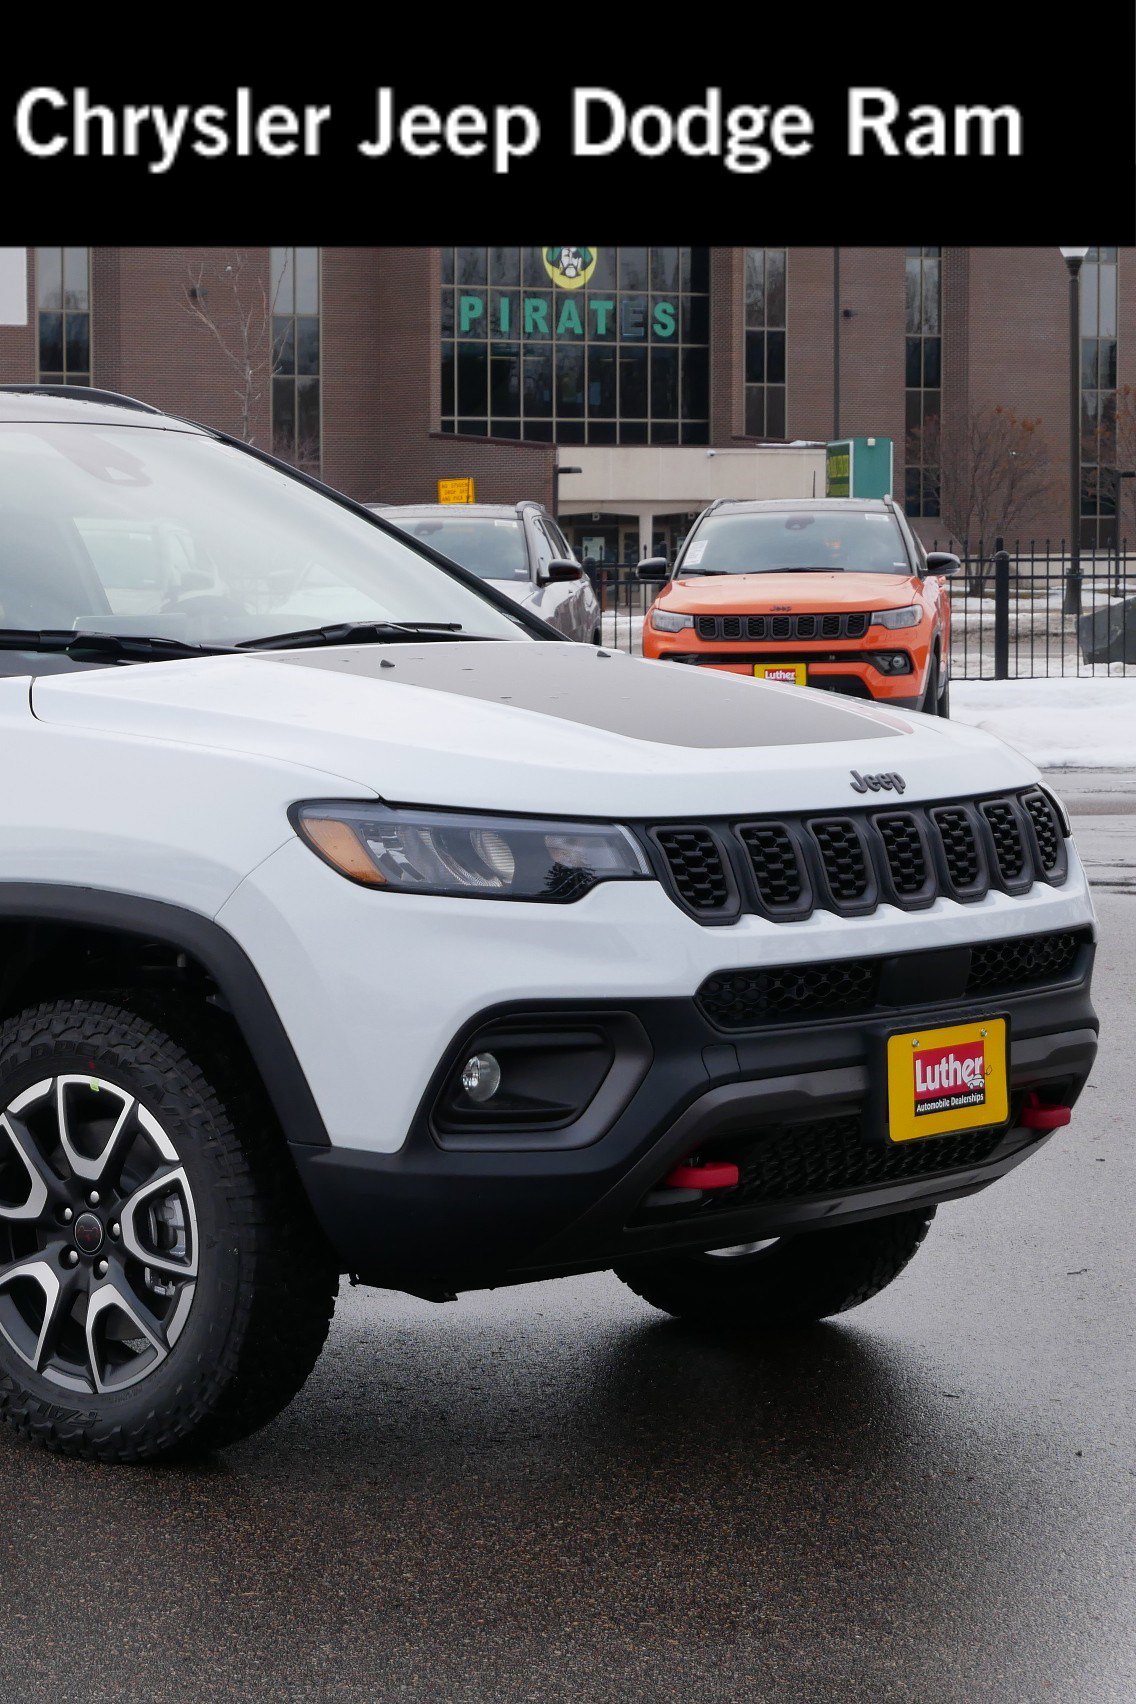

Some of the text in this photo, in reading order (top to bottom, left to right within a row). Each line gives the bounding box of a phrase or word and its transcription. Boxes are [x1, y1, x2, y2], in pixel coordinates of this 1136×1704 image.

[459, 295, 677, 338] PIRATES
[764, 670, 796, 681] Luther
[850, 769, 906, 795] Jeep
[915, 1053, 983, 1092] Luther
[916, 1092, 984, 1112] Automobile Dealerships
